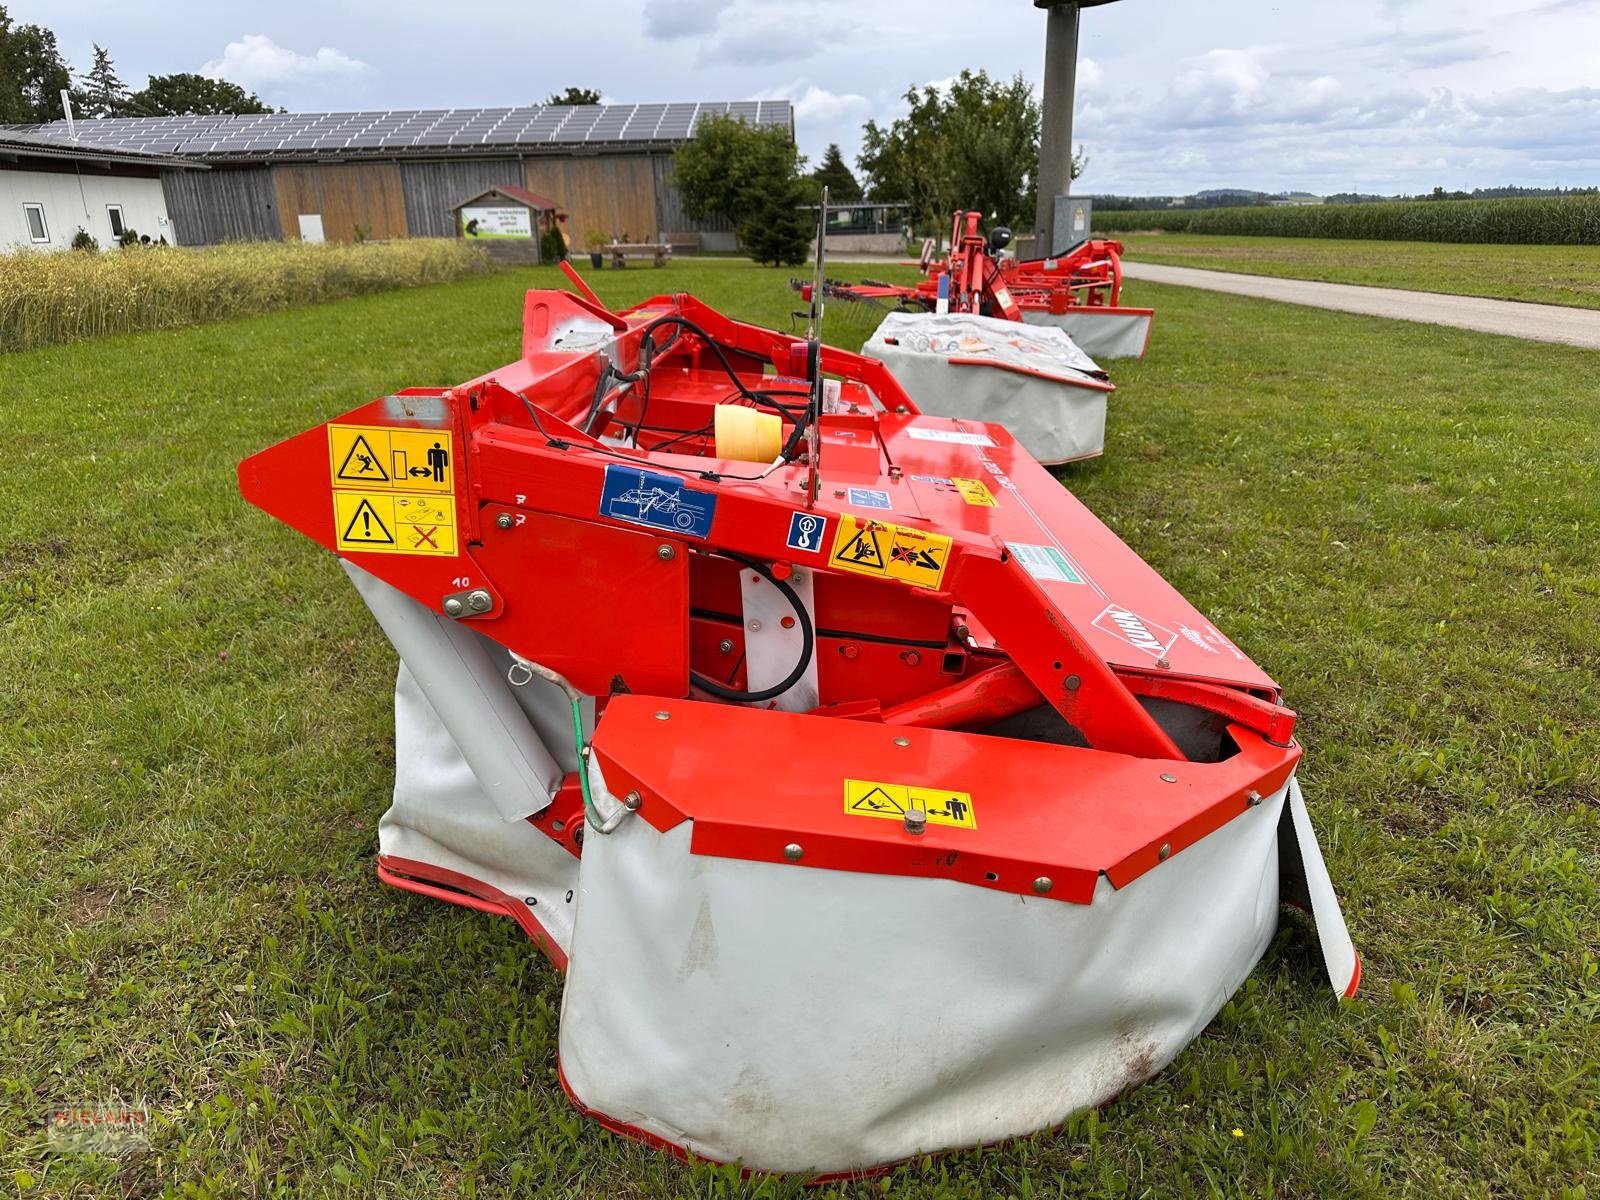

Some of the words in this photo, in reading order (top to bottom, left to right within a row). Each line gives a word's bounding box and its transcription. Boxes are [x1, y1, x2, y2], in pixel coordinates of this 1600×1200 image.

[515, 514, 526, 527] 7
[451, 577, 470, 588] 10
[1106, 609, 1167, 651] KUHN
